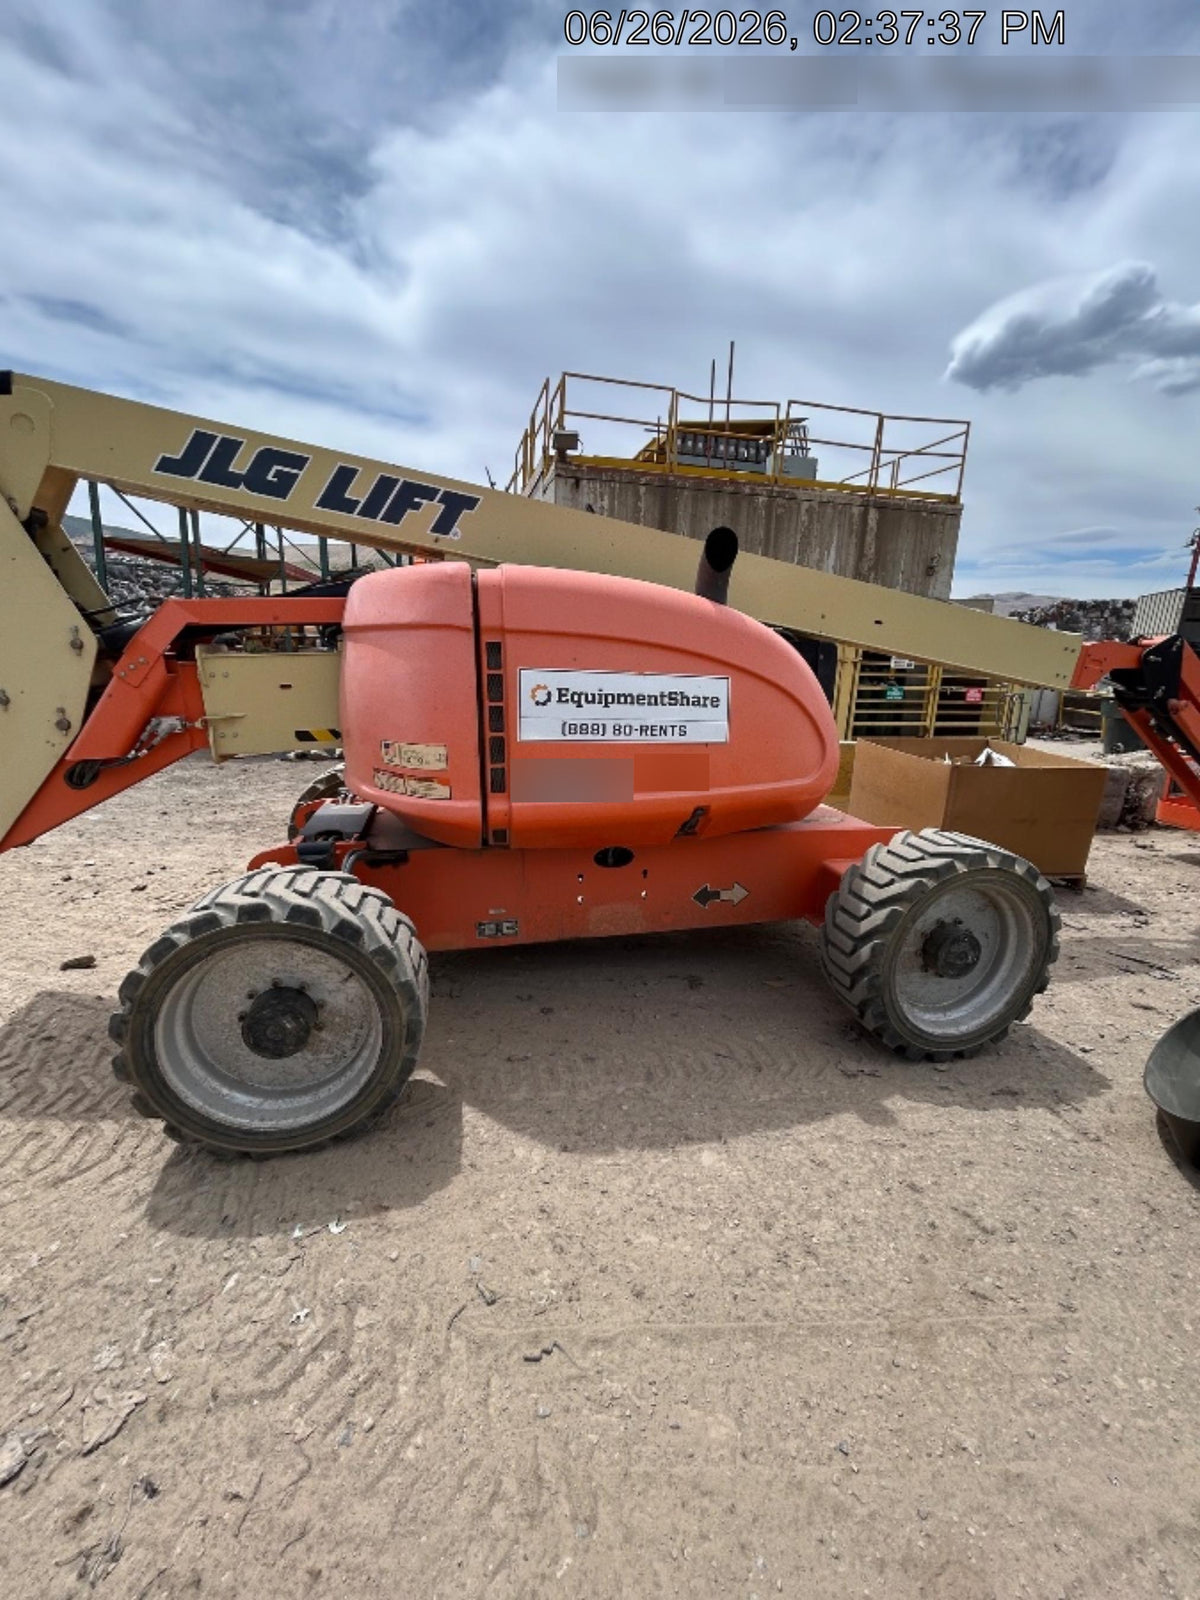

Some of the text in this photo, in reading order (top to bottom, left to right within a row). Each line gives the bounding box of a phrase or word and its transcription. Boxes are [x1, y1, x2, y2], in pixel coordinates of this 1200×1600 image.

[153, 429, 483, 537] JLG LIFT
[556, 688, 721, 709] EquipmentShare
[561, 721, 688, 738] (888) 80-RENTS
